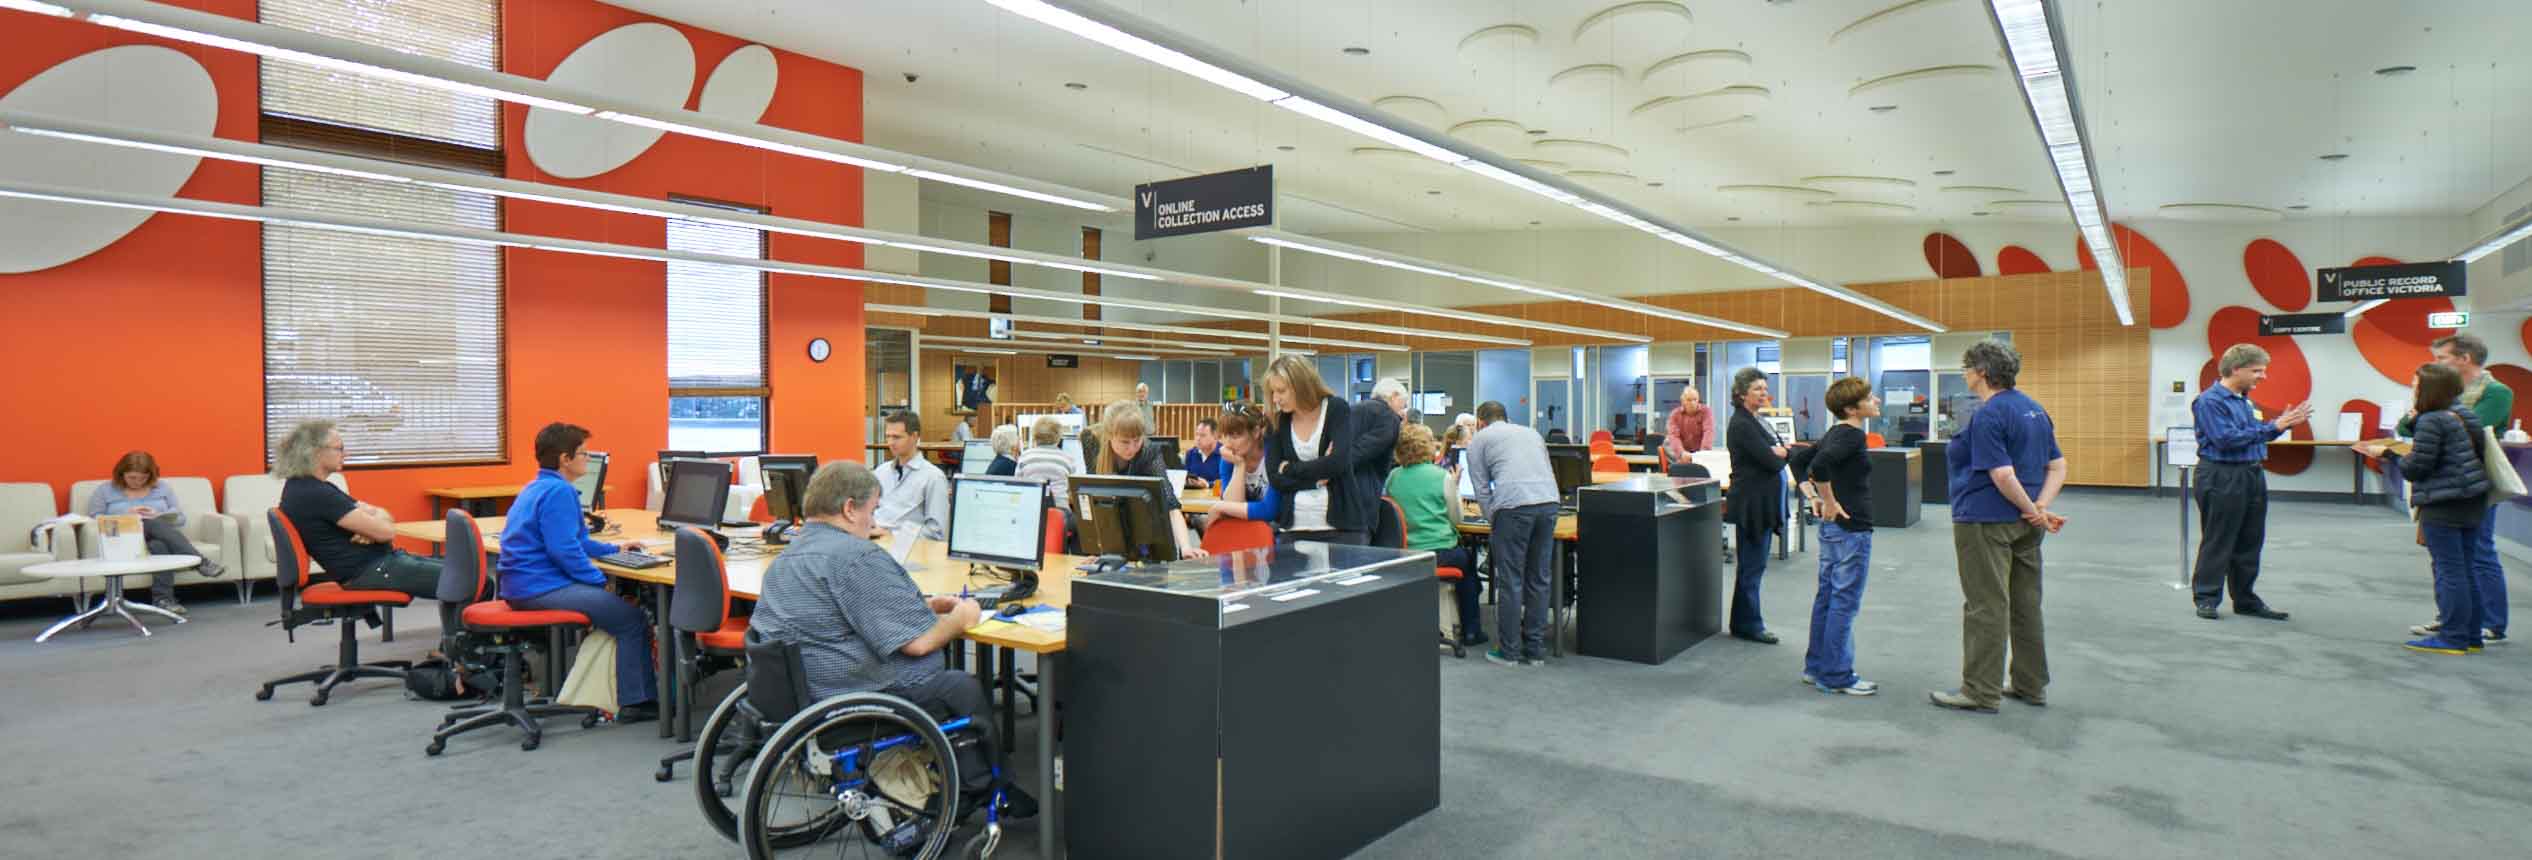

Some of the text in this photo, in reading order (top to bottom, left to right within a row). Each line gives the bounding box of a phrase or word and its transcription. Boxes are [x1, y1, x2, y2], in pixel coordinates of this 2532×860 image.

[1158, 200, 1195, 216] ONLINE
[1158, 203, 1265, 228] COLLECTION ACCESS
[2343, 275, 2438, 288] PUBLIC RECORD
[2343, 283, 2443, 296] OFFICE VICTORIA
